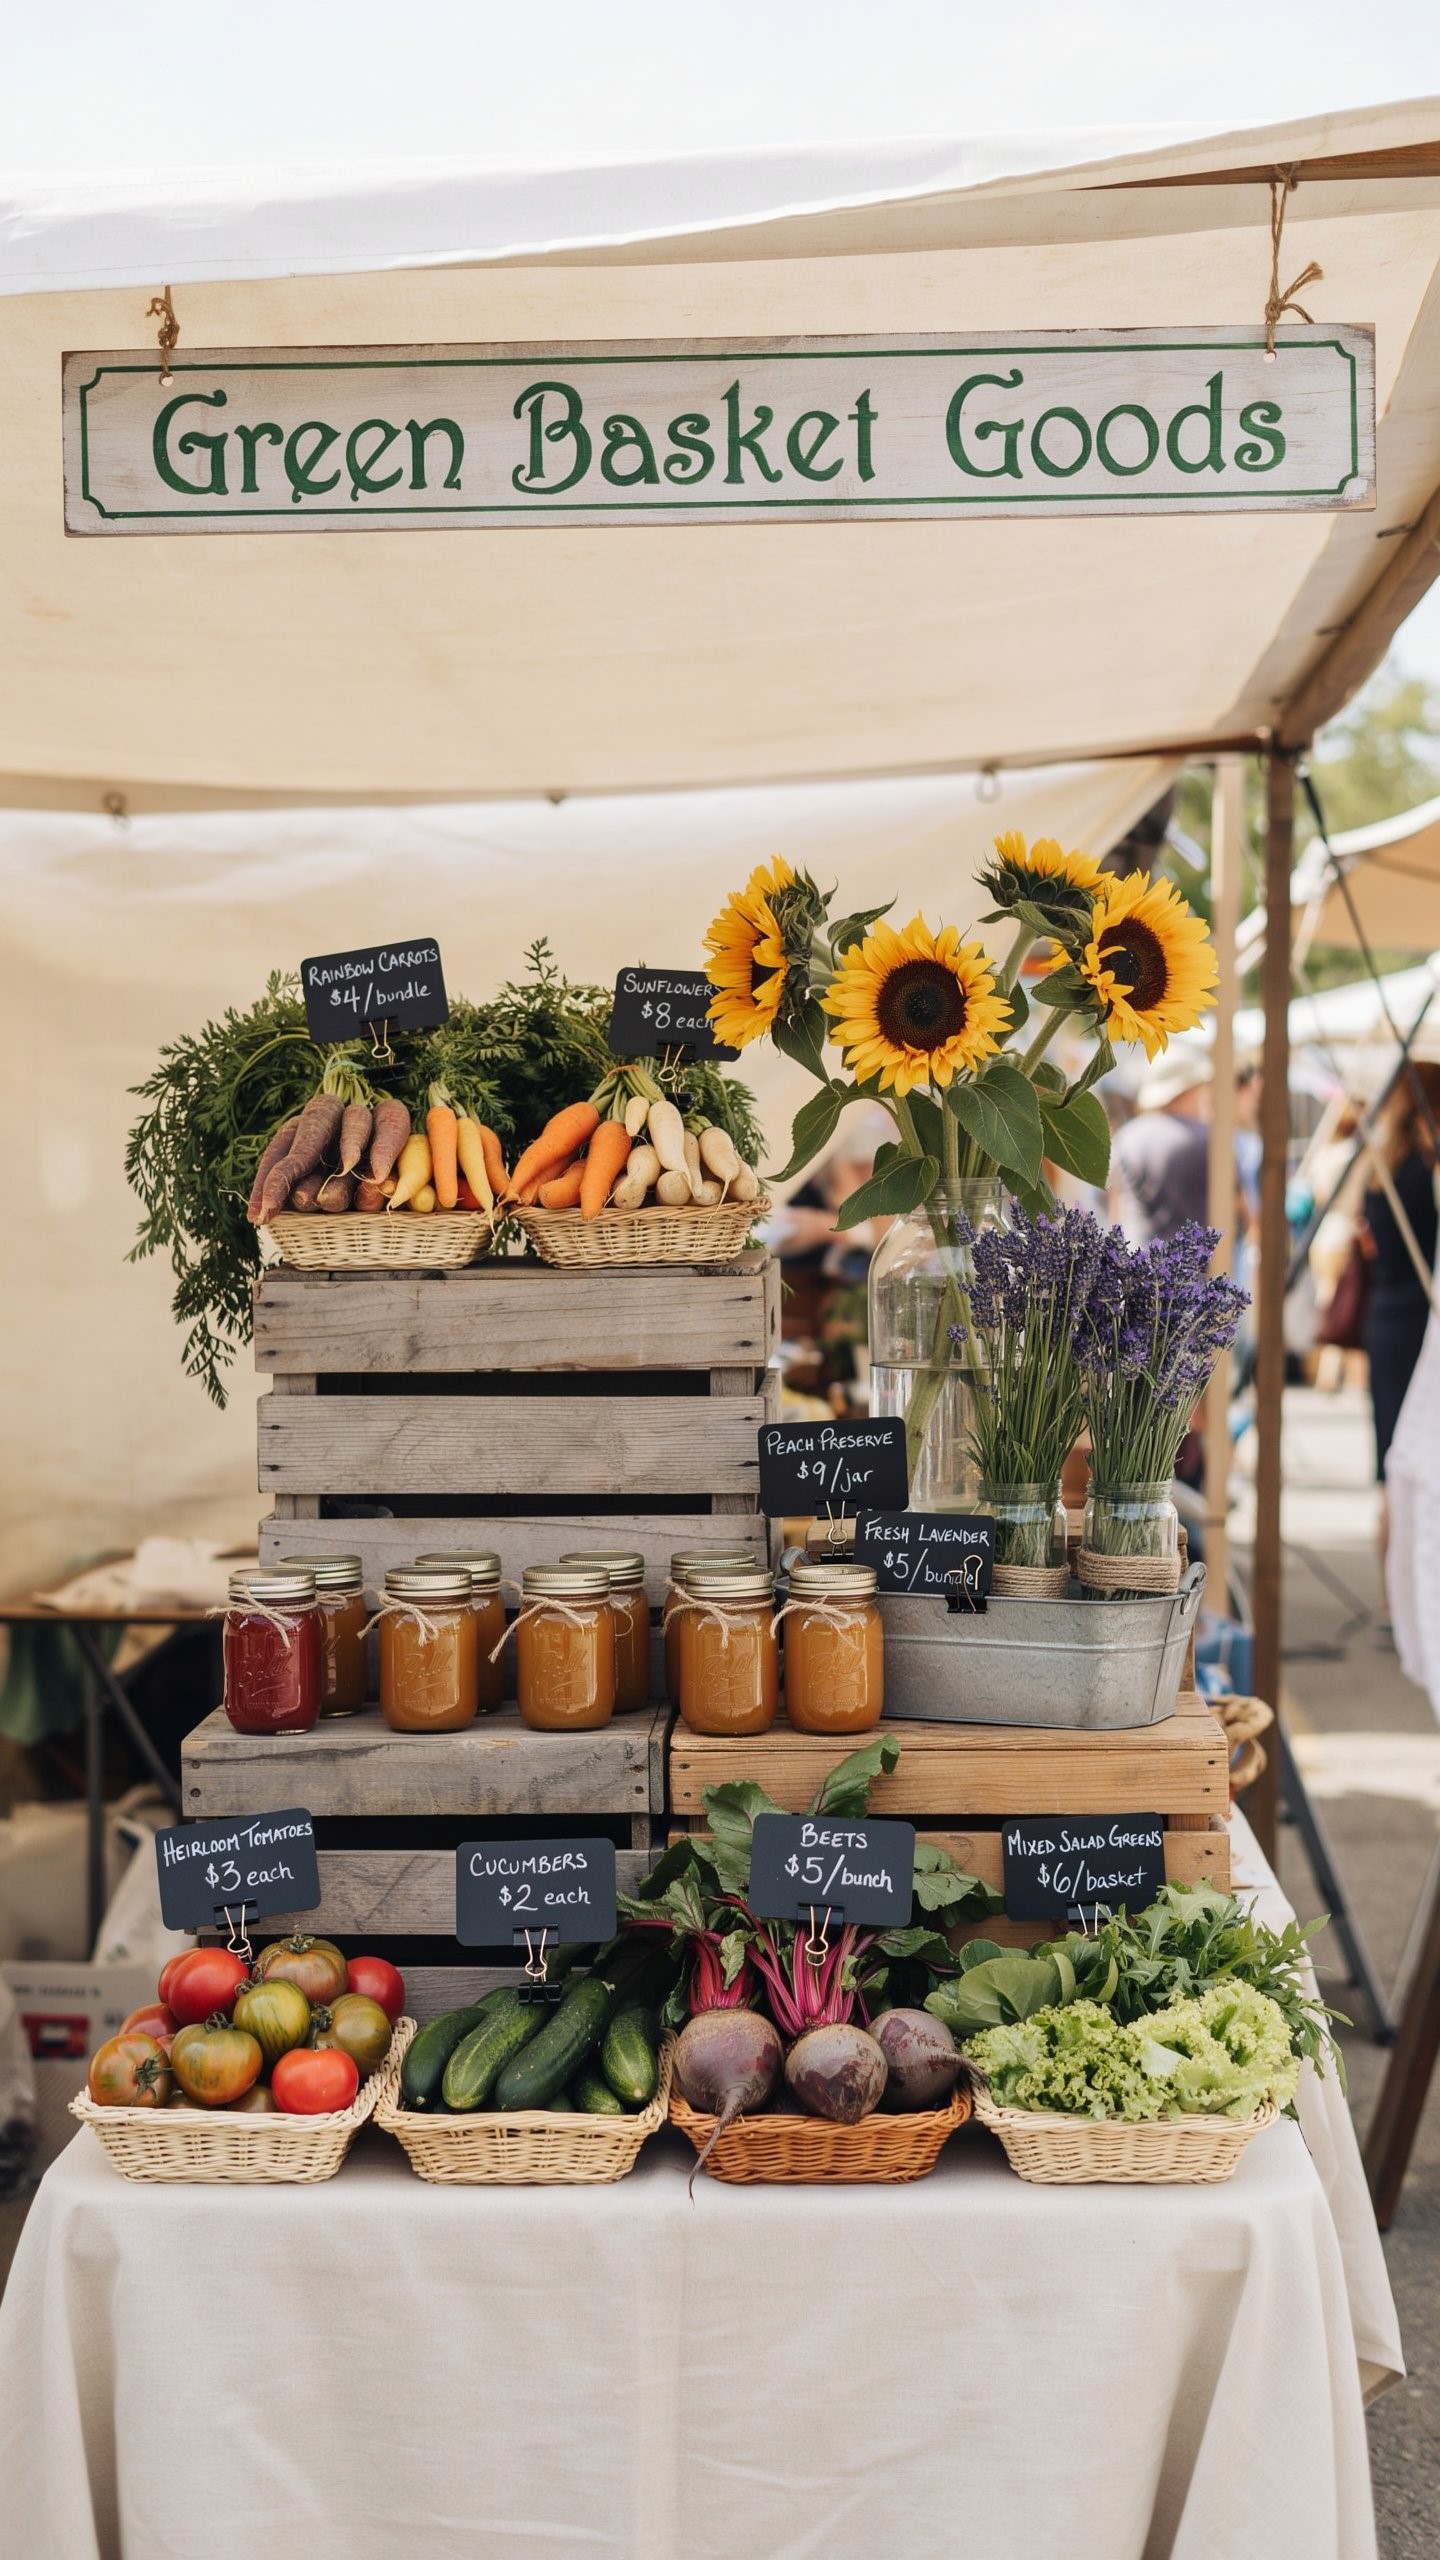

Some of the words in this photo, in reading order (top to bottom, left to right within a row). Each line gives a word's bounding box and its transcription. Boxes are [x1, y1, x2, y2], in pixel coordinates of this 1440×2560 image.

[153, 388, 464, 503] Green
[512, 379, 879, 495] Basket
[946, 366, 1286, 480] Goods
[308, 959, 374, 986] RAINBOW
[378, 948, 438, 972] CARROTS
[329, 982, 432, 1015] $4/bundle
[624, 973, 722, 997] SUNFLOWER
[641, 1000, 671, 1029] $8
[766, 1430, 814, 1455] PEACH
[821, 1428, 892, 1450] PRESERVE
[797, 1458, 873, 1493] $9/jar
[865, 1518, 909, 1543] FRESH
[919, 1524, 989, 1546] LAVENDER
[883, 1548, 974, 1591] $5/bunde
[163, 1834, 240, 1867] HEIRLOOM
[240, 1822, 312, 1847] TOMATOES
[800, 1823, 867, 1848] BEETS
[1008, 1830, 1055, 1856] MIXED
[1060, 1831, 1105, 1852] SALAD
[1109, 1825, 1161, 1848] GREENS
[205, 1861, 241, 1891] $3
[247, 1862, 294, 1886] each
[470, 1853, 587, 1876] CUCUMBERS
[785, 1854, 893, 1895] $5/bunch
[1038, 1861, 1146, 1898] $6/basket
[499, 1884, 538, 1911] $2
[545, 1887, 590, 1904] each
